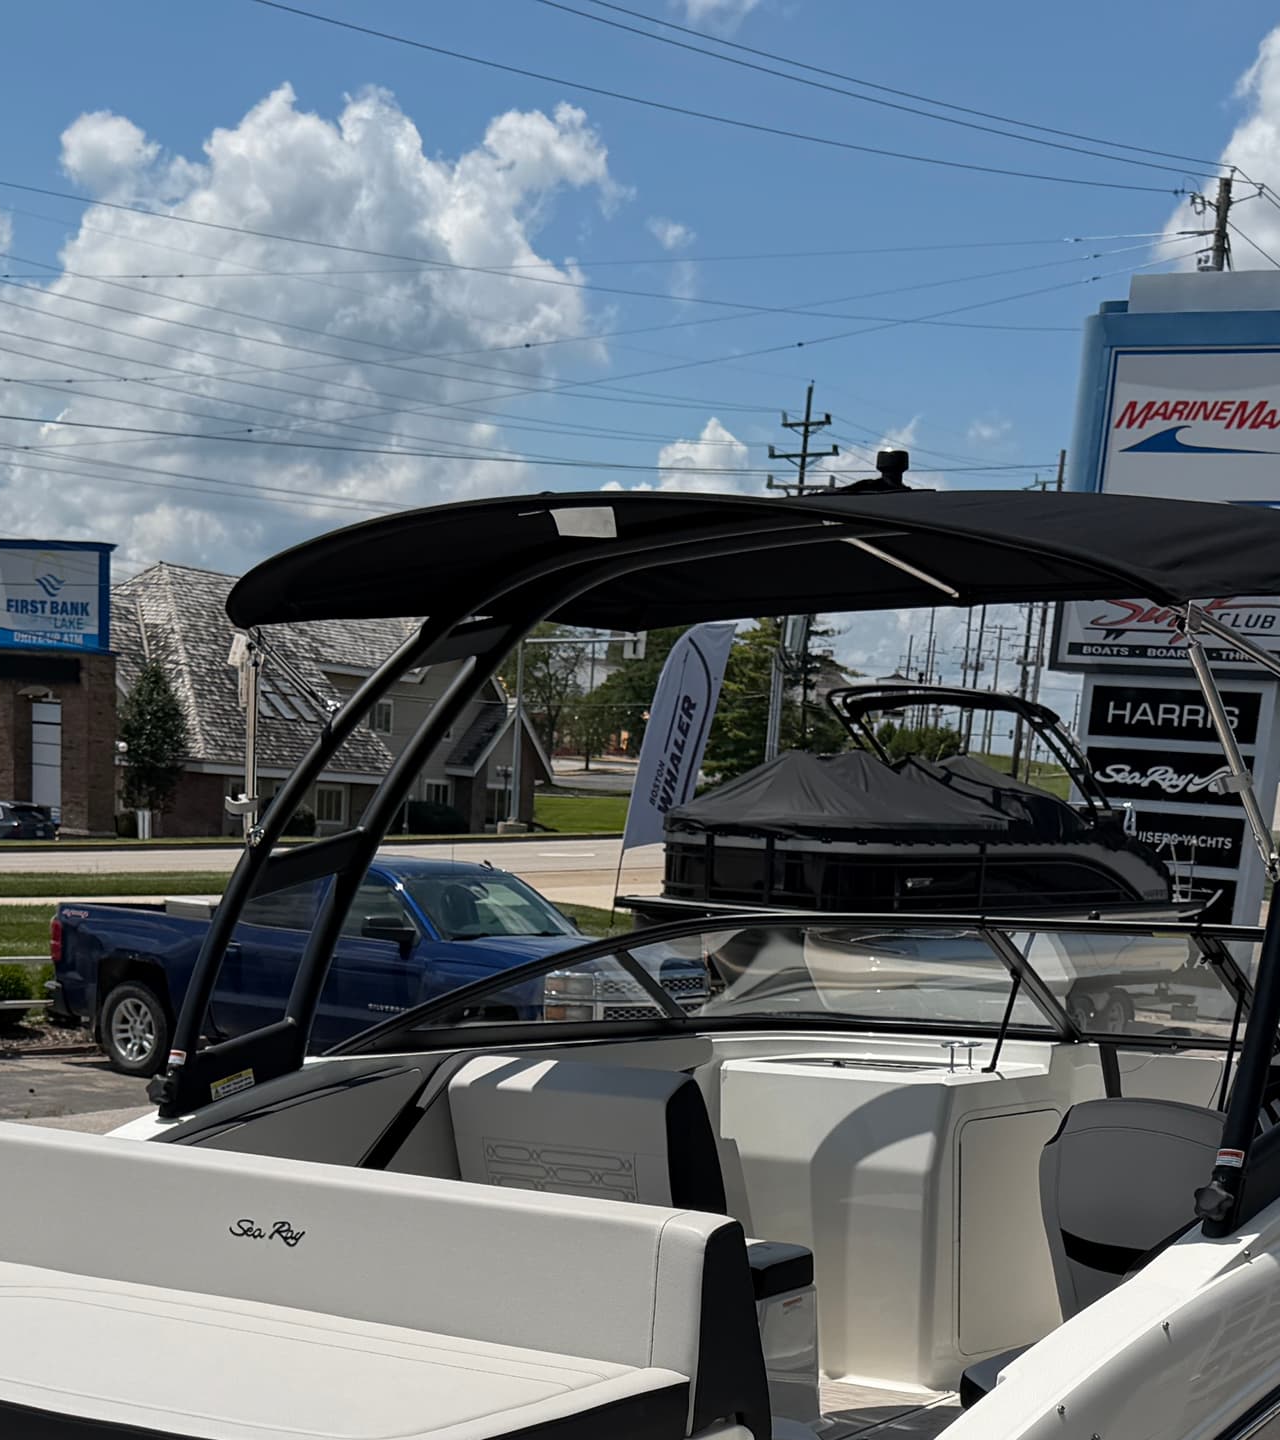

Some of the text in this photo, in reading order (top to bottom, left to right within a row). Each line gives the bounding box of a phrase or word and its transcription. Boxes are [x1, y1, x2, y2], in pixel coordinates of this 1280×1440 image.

[6, 598, 90, 616] FIRST BANK
[53, 617, 85, 630] LAKE
[1081, 645, 1129, 657] BOATS
[657, 694, 698, 815] WHALER
[649, 759, 666, 807] BOSTON
[1183, 833, 1233, 850] YACHTS
[228, 1218, 306, 1248] Sea Ray
